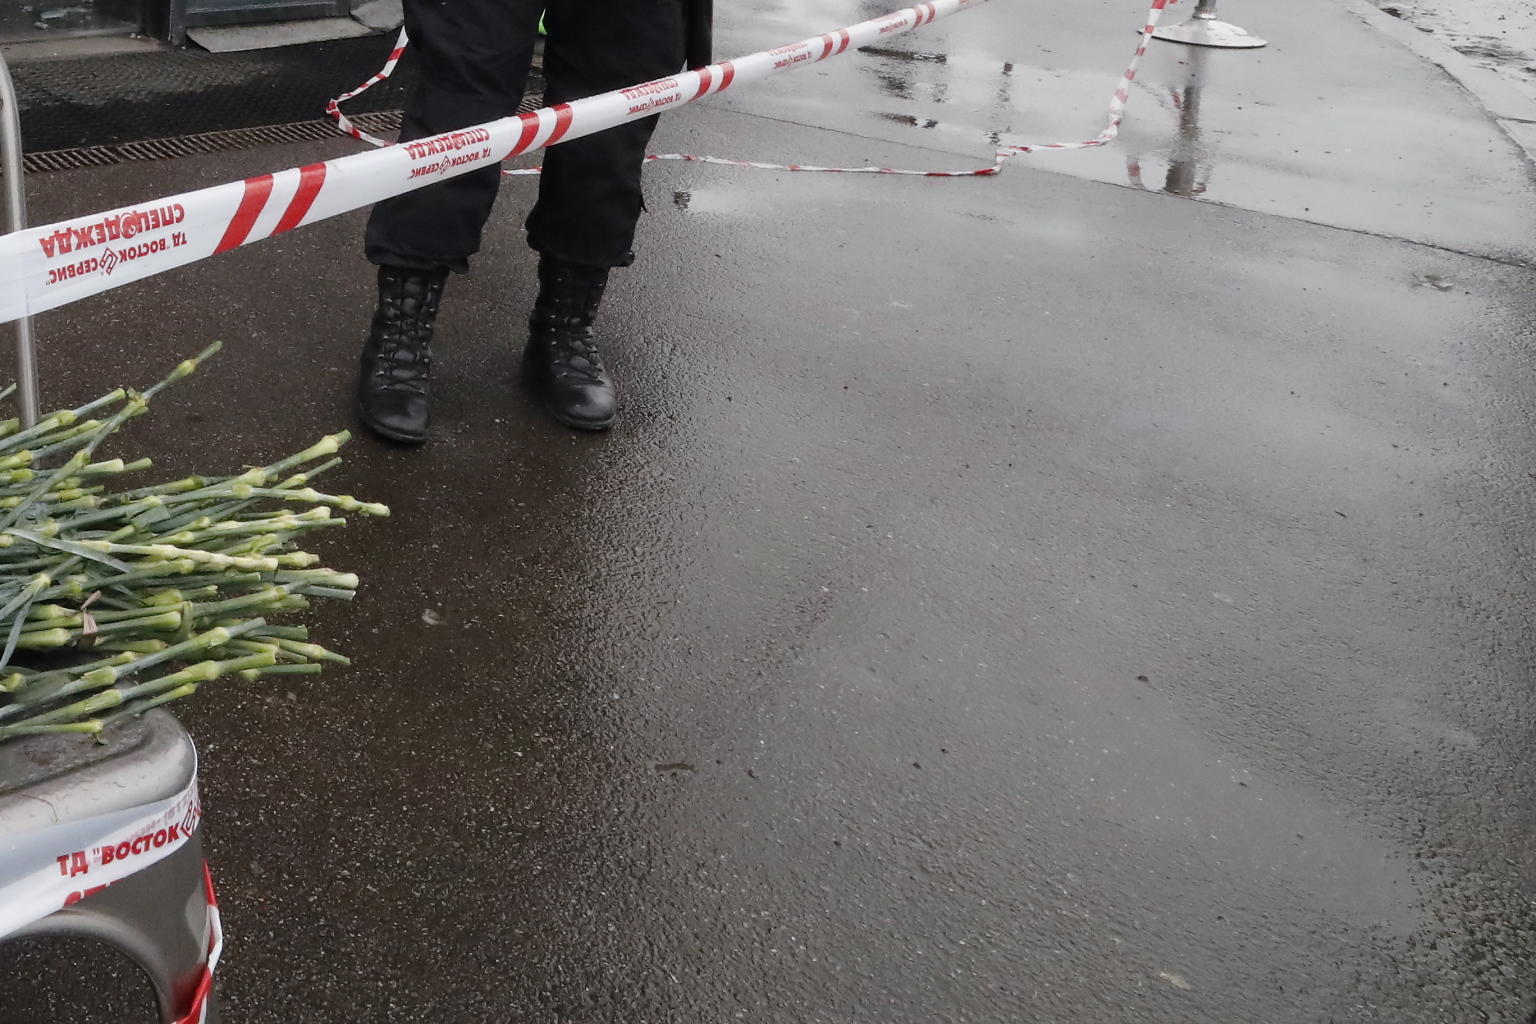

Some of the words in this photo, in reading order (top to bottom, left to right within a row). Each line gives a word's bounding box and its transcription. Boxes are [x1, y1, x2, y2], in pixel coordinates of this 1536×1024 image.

[38, 203, 185, 258] СПЕЦОДЕЖДА
[172, 232, 187, 247] ТД
[56, 850, 89, 878] ТД
